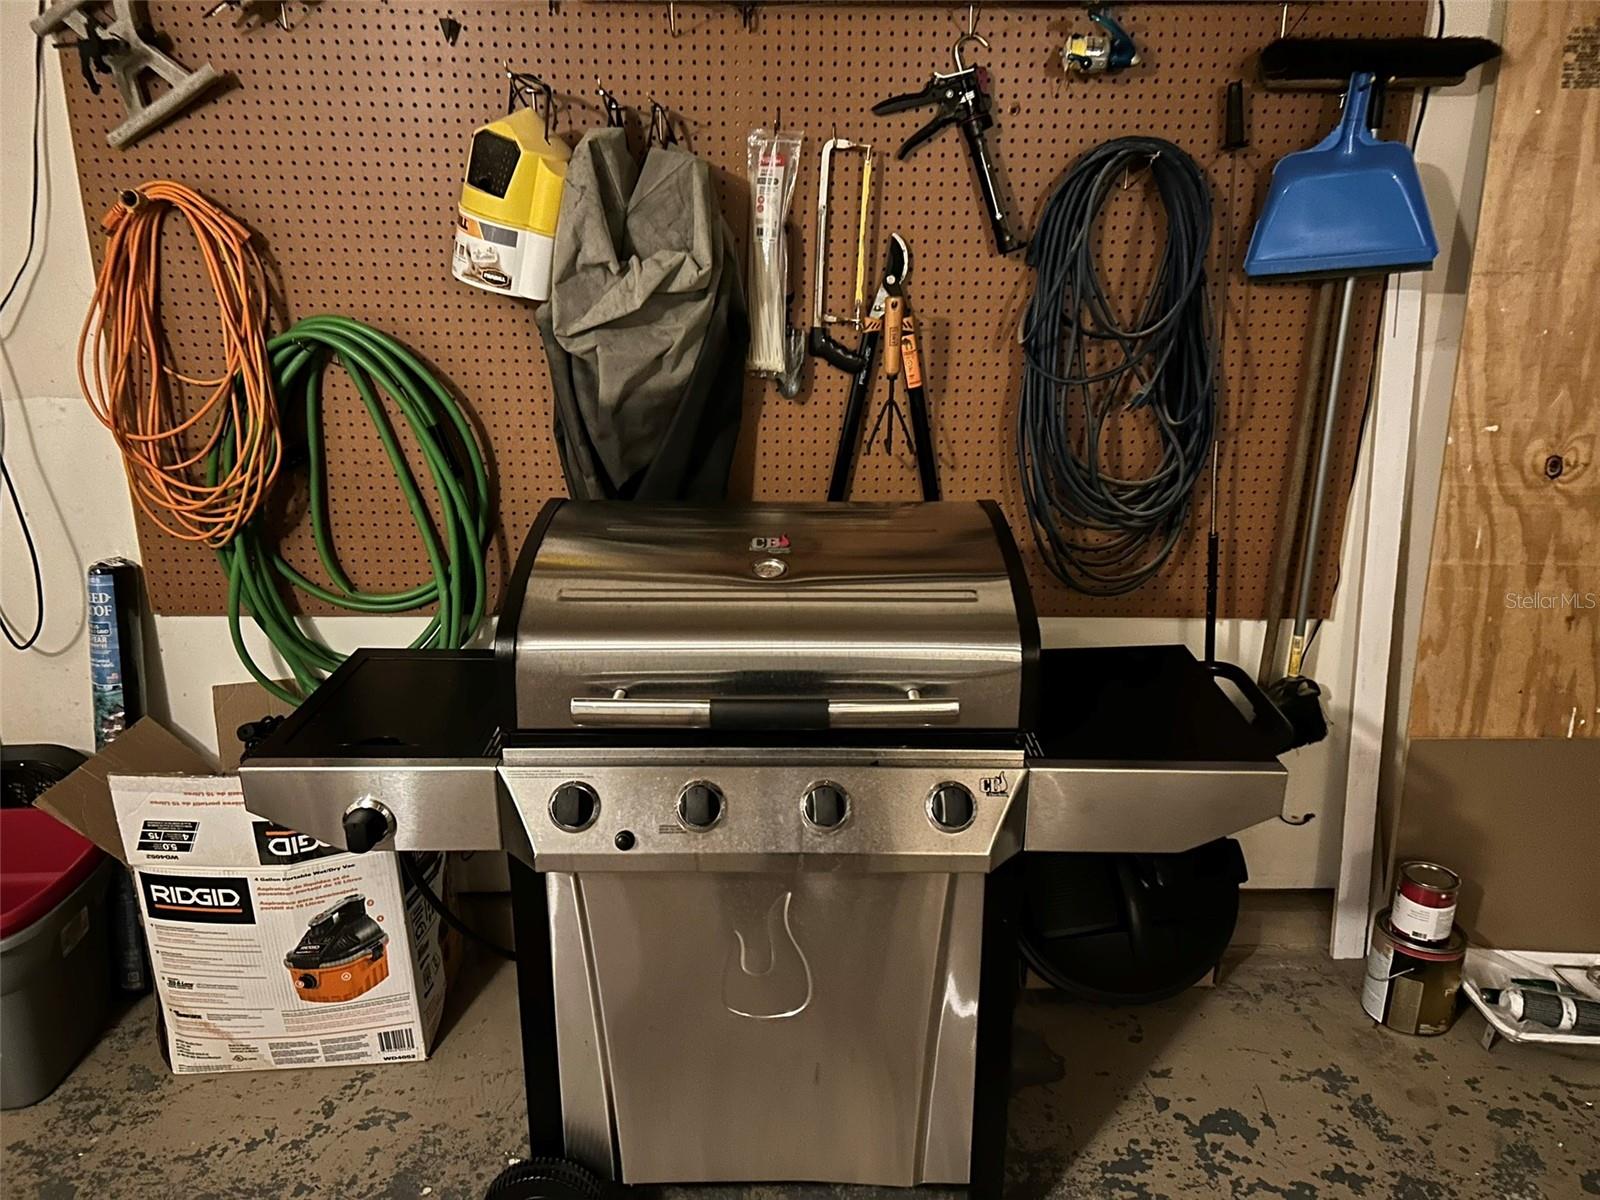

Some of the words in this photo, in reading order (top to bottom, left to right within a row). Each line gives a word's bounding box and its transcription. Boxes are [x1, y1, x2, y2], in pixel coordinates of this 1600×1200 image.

[148, 832, 160, 840] 15
[182, 833, 190, 841] 4
[162, 843, 178, 851] 5.0
[282, 872, 312, 881] Portable
[313, 866, 340, 875] Wet/Dry
[150, 884, 240, 906] RIDGID
